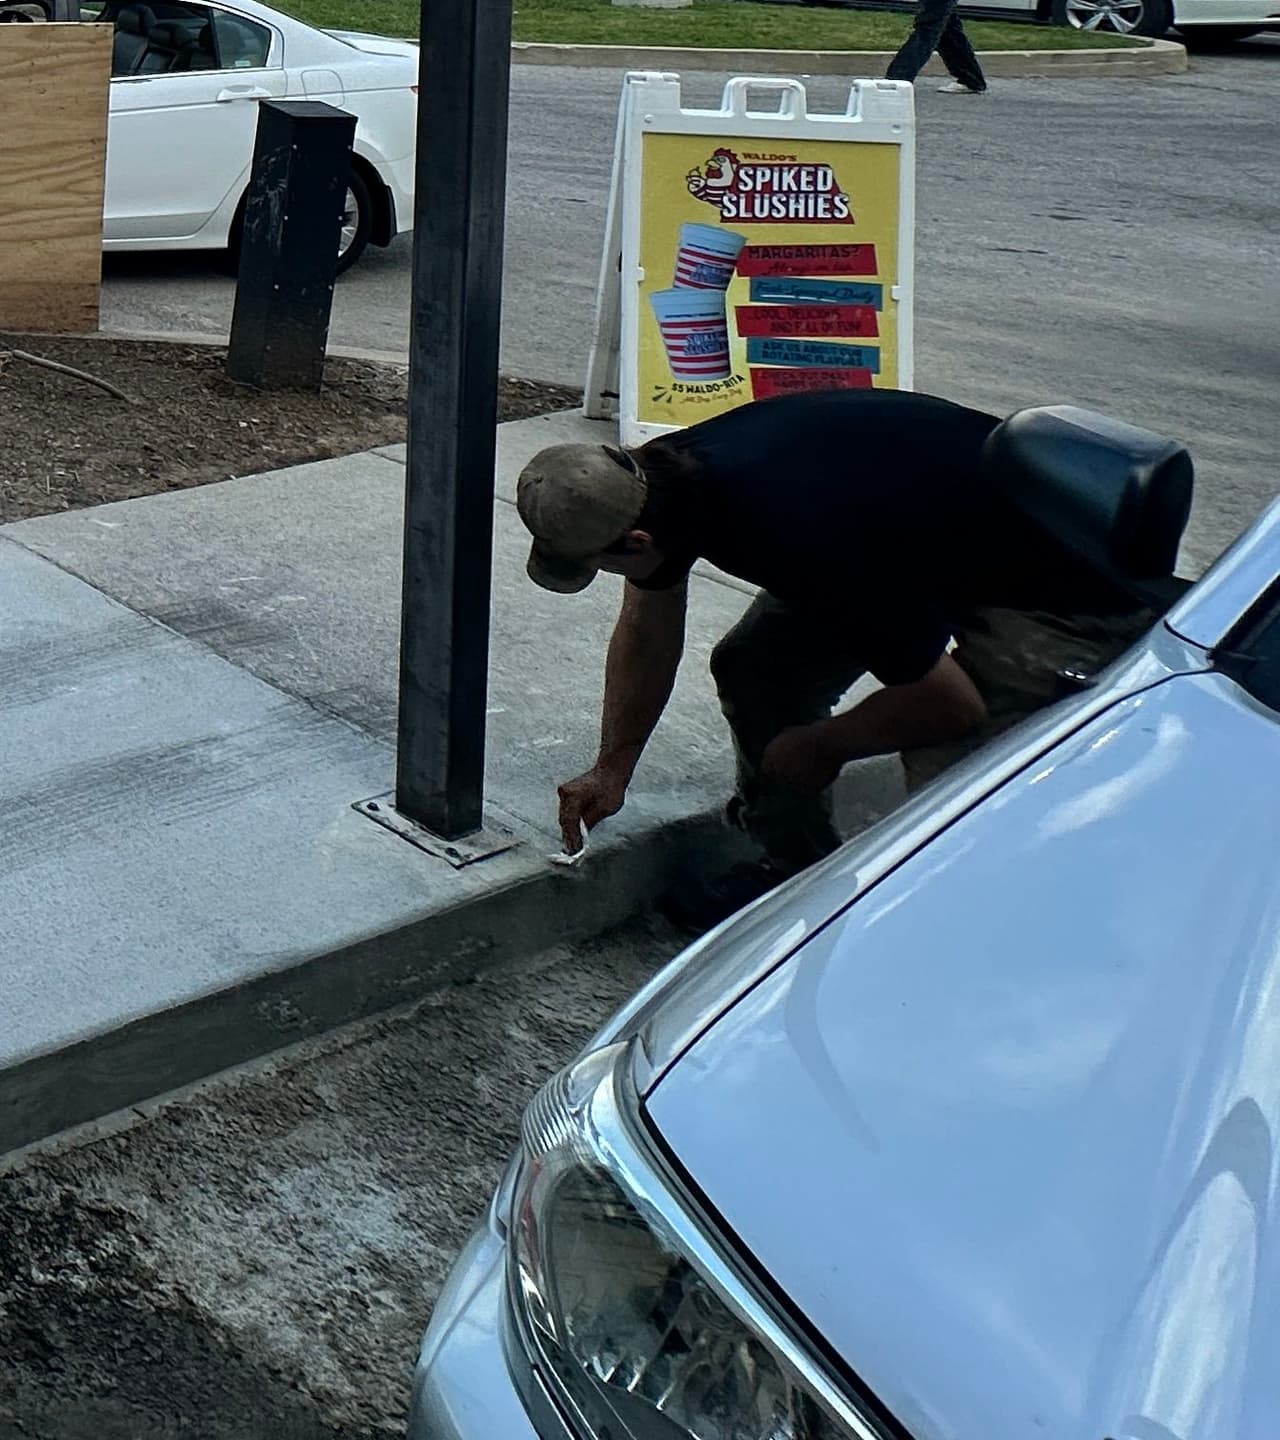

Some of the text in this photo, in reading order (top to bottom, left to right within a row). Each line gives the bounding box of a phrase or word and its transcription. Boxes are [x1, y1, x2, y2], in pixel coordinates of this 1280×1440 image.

[741, 152, 797, 161] WALDO'S
[738, 166, 834, 192] SPIKED
[721, 192, 850, 219] SLUSHIES
[685, 374, 746, 394] WALDO-RITA
